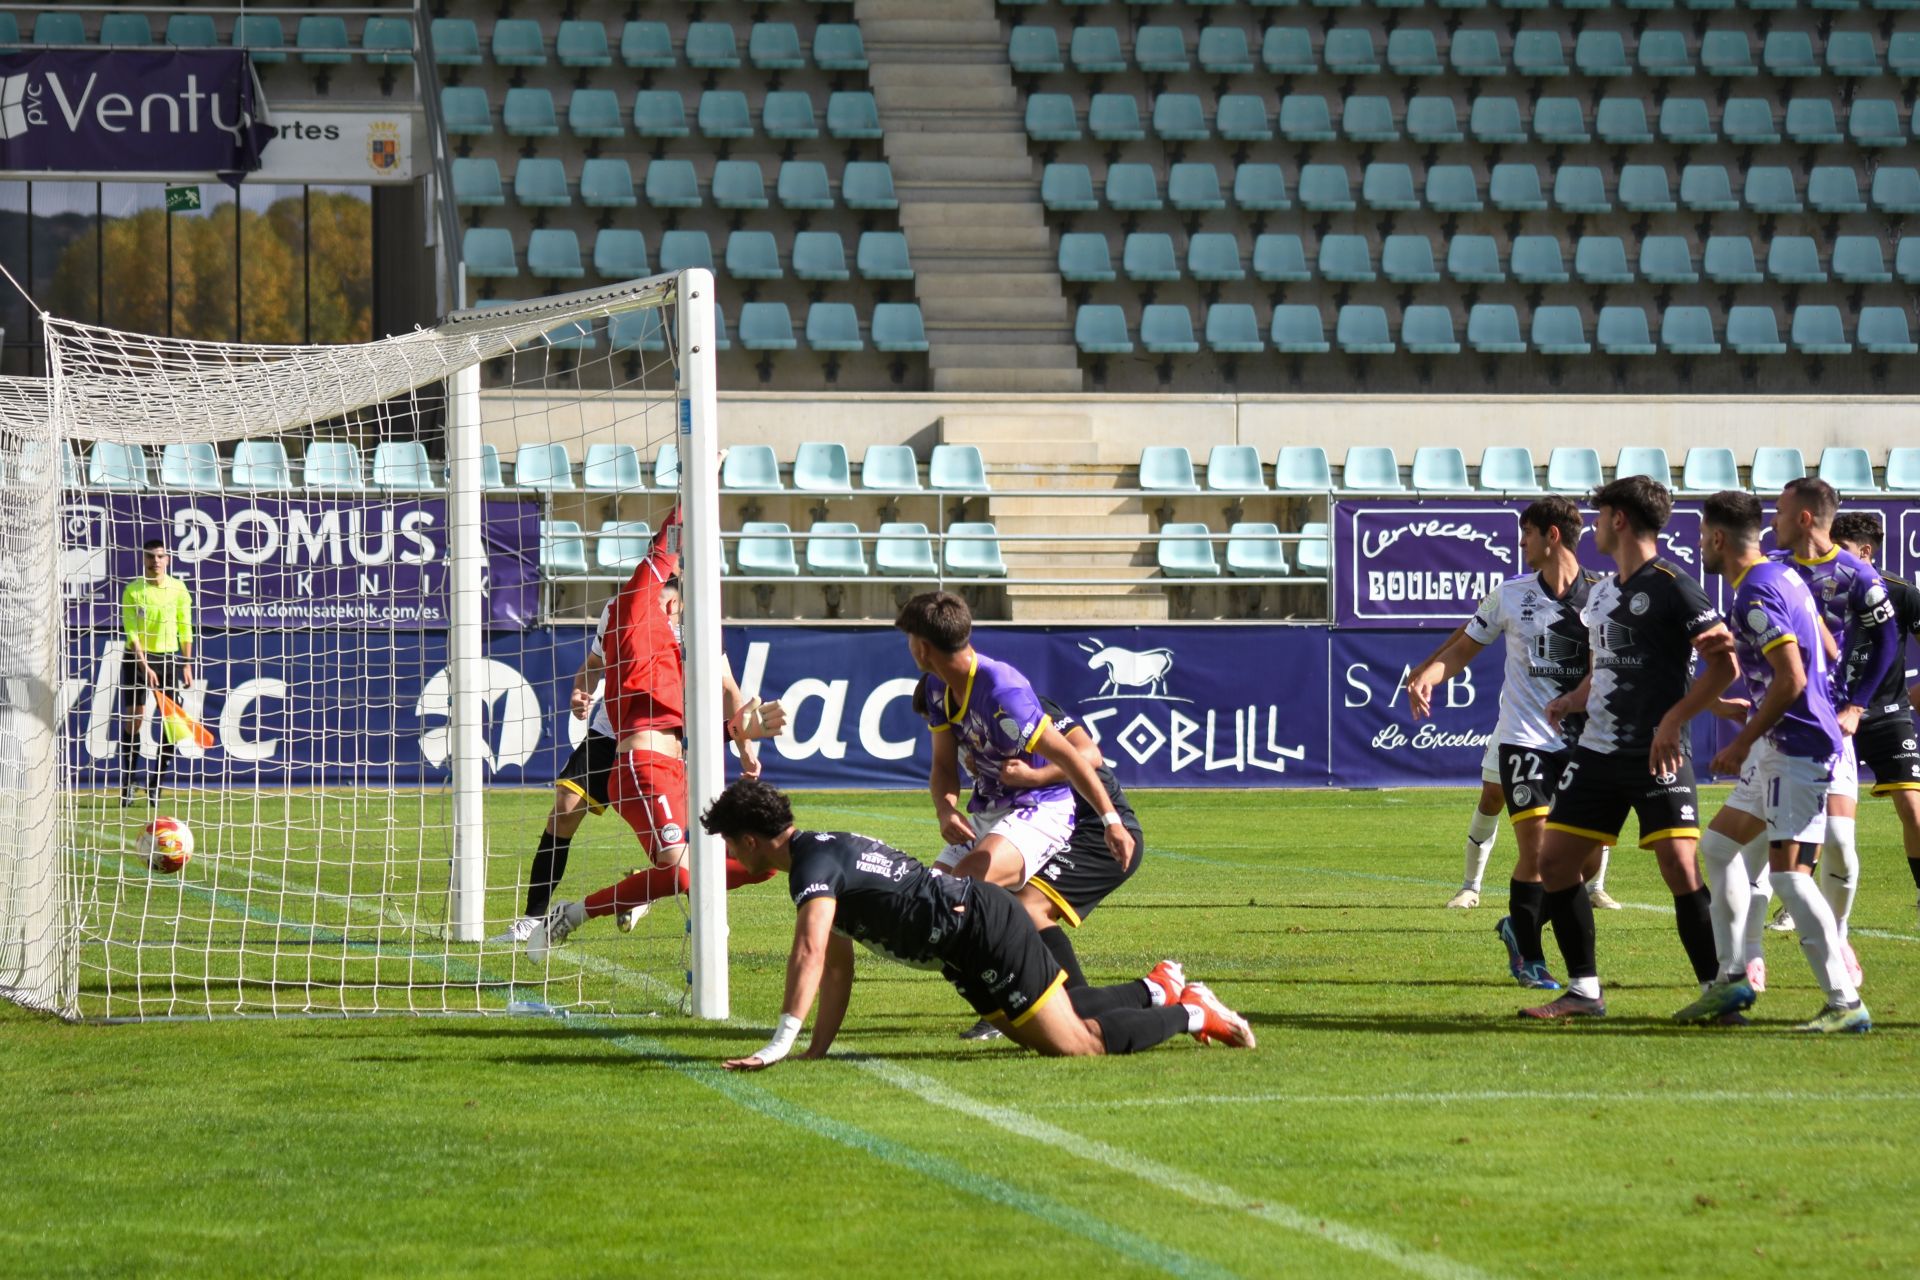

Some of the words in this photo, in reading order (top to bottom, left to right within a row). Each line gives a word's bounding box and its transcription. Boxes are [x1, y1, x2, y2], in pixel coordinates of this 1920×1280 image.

[173, 507, 491, 568] DOMUS
[222, 605, 440, 621] www.domusateknik.com/es
[1372, 723, 1408, 750] La
[1508, 752, 1543, 784] 22
[1558, 761, 1580, 790] 5
[657, 794, 673, 820] 1
